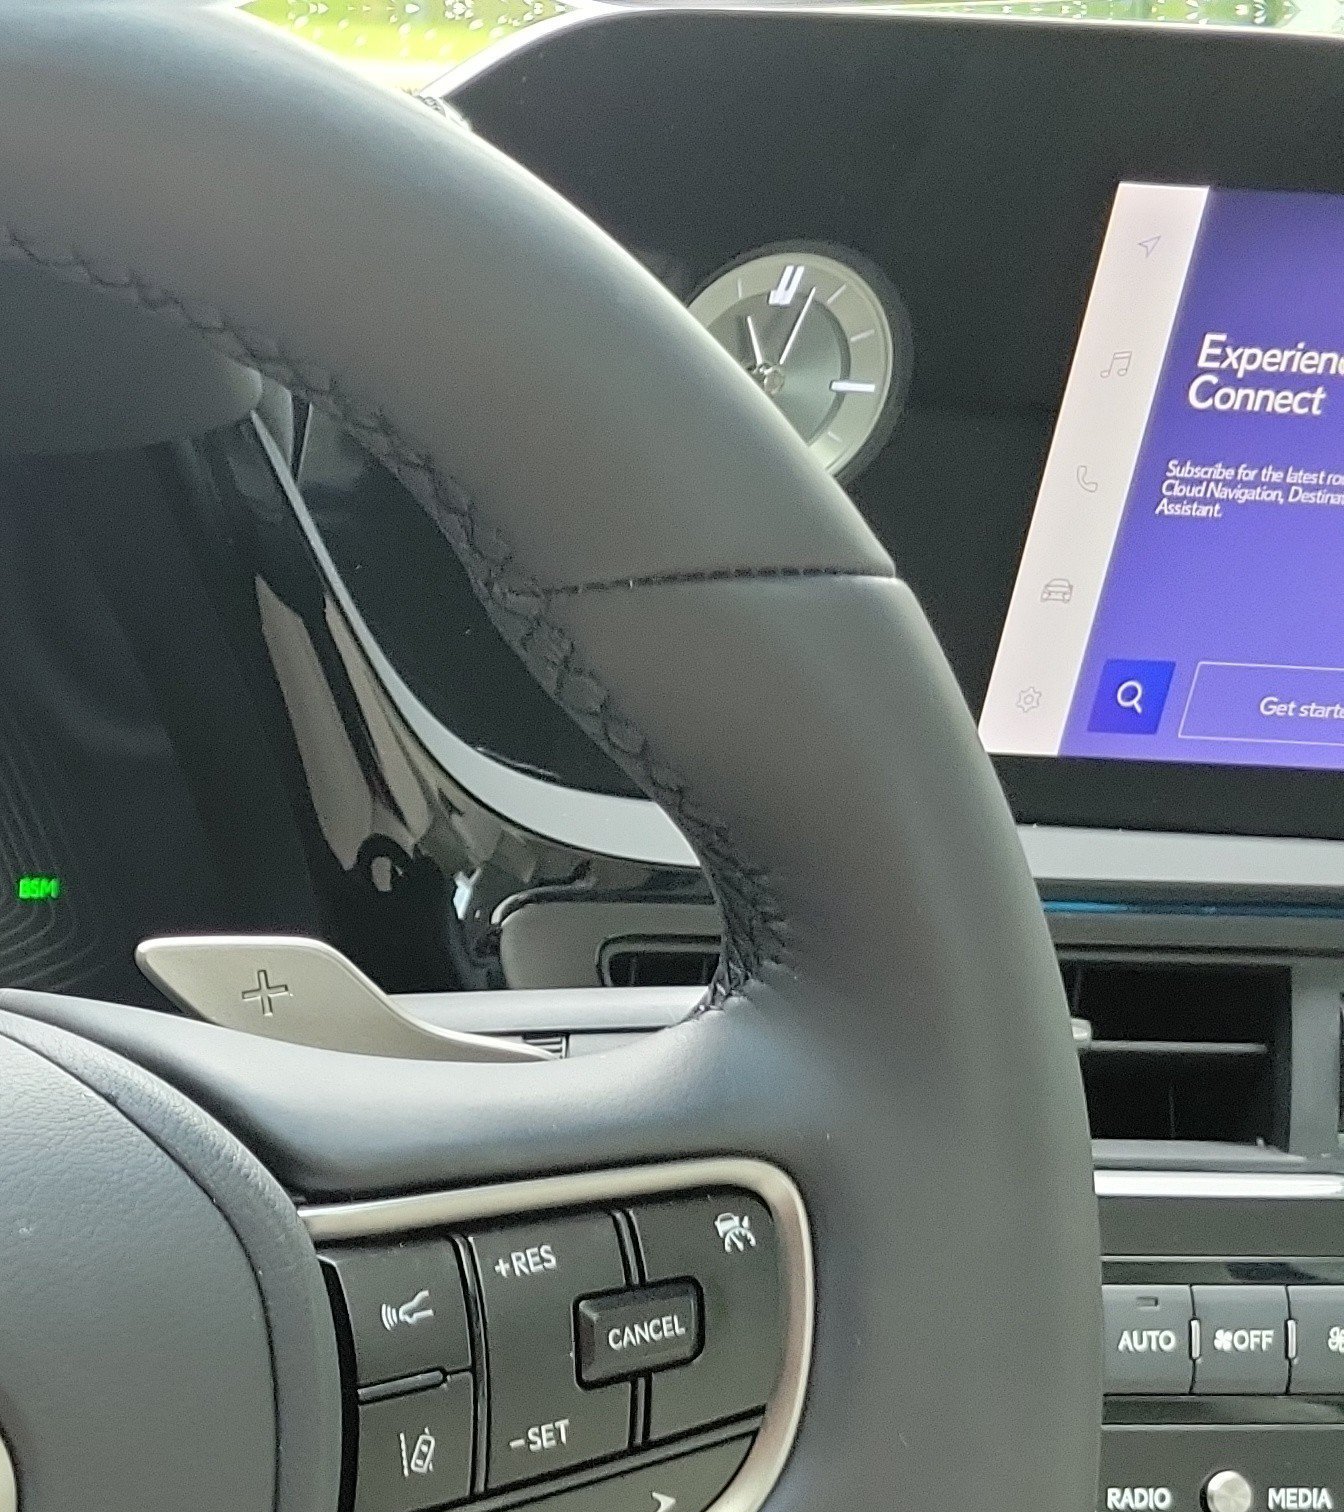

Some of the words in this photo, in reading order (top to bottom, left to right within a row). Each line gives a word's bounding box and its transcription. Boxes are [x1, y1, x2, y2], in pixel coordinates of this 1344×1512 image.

[1187, 373, 1327, 416] Connect
[1165, 459, 1235, 481] Subscribe
[1237, 461, 1258, 482] for
[1261, 464, 1284, 483] the
[1286, 465, 1325, 485] latest
[1161, 478, 1206, 499] Cloud
[1207, 479, 1284, 505] Navigation,
[1154, 500, 1223, 518] Assistant.
[1259, 695, 1297, 717] Get
[608, 1314, 687, 1350] CANCEL
[1117, 1328, 1178, 1353] AUTO
[1232, 1328, 1276, 1352] OFF
[1106, 1486, 1174, 1511] RADIO
[1267, 1486, 1334, 1511] MEDIA
